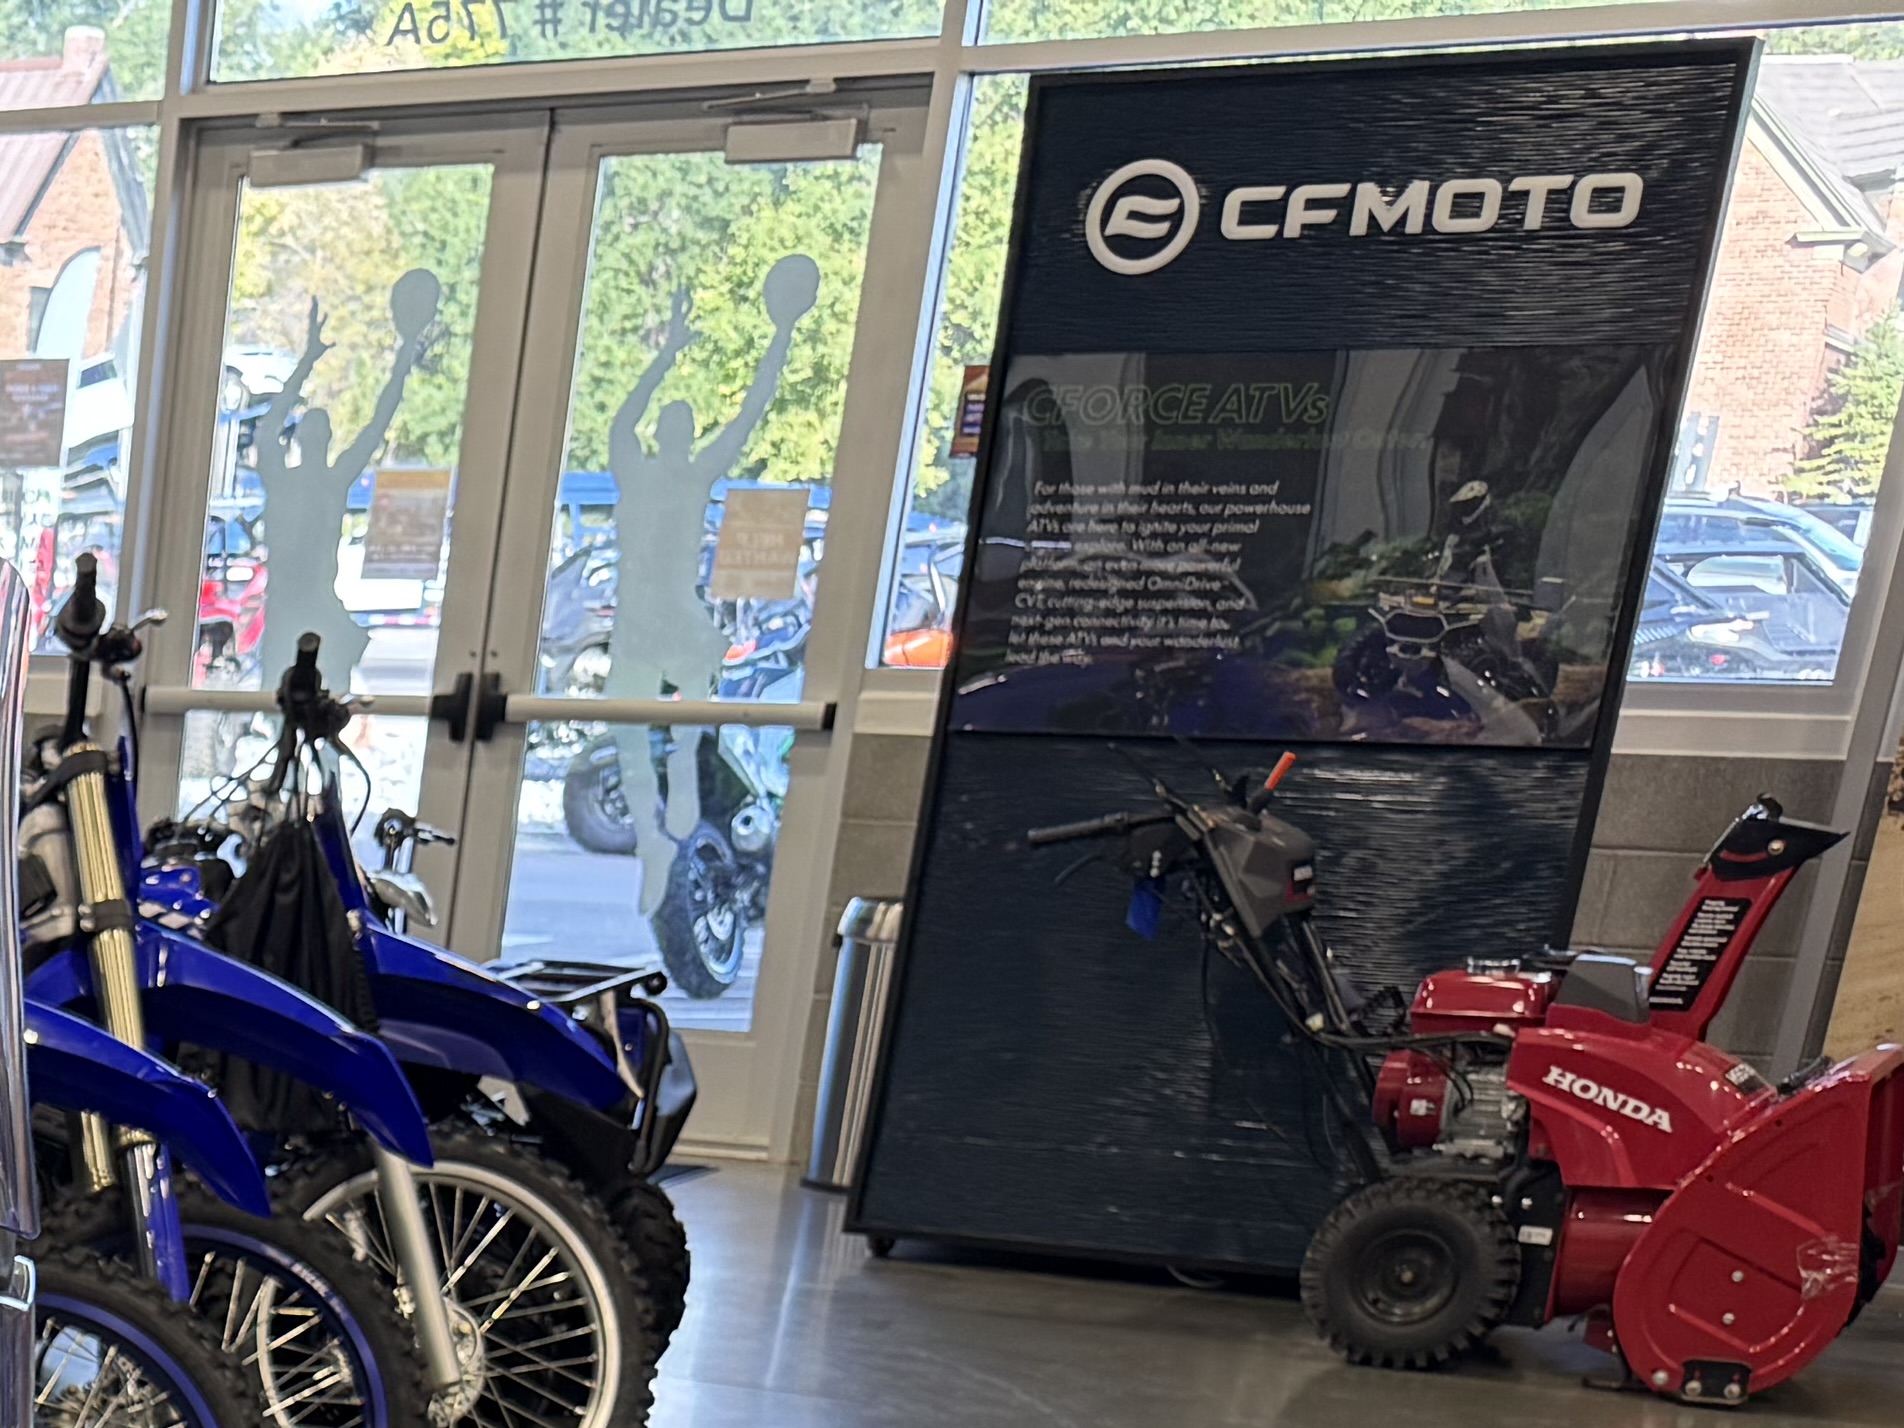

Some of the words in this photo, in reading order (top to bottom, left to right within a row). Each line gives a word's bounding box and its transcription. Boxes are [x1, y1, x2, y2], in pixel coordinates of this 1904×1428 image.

[1220, 172, 1644, 241] CFMOTO
[1024, 384, 1208, 427] CFORCE
[1206, 383, 1331, 426] ATVs
[1543, 1064, 1673, 1134] HONDA
